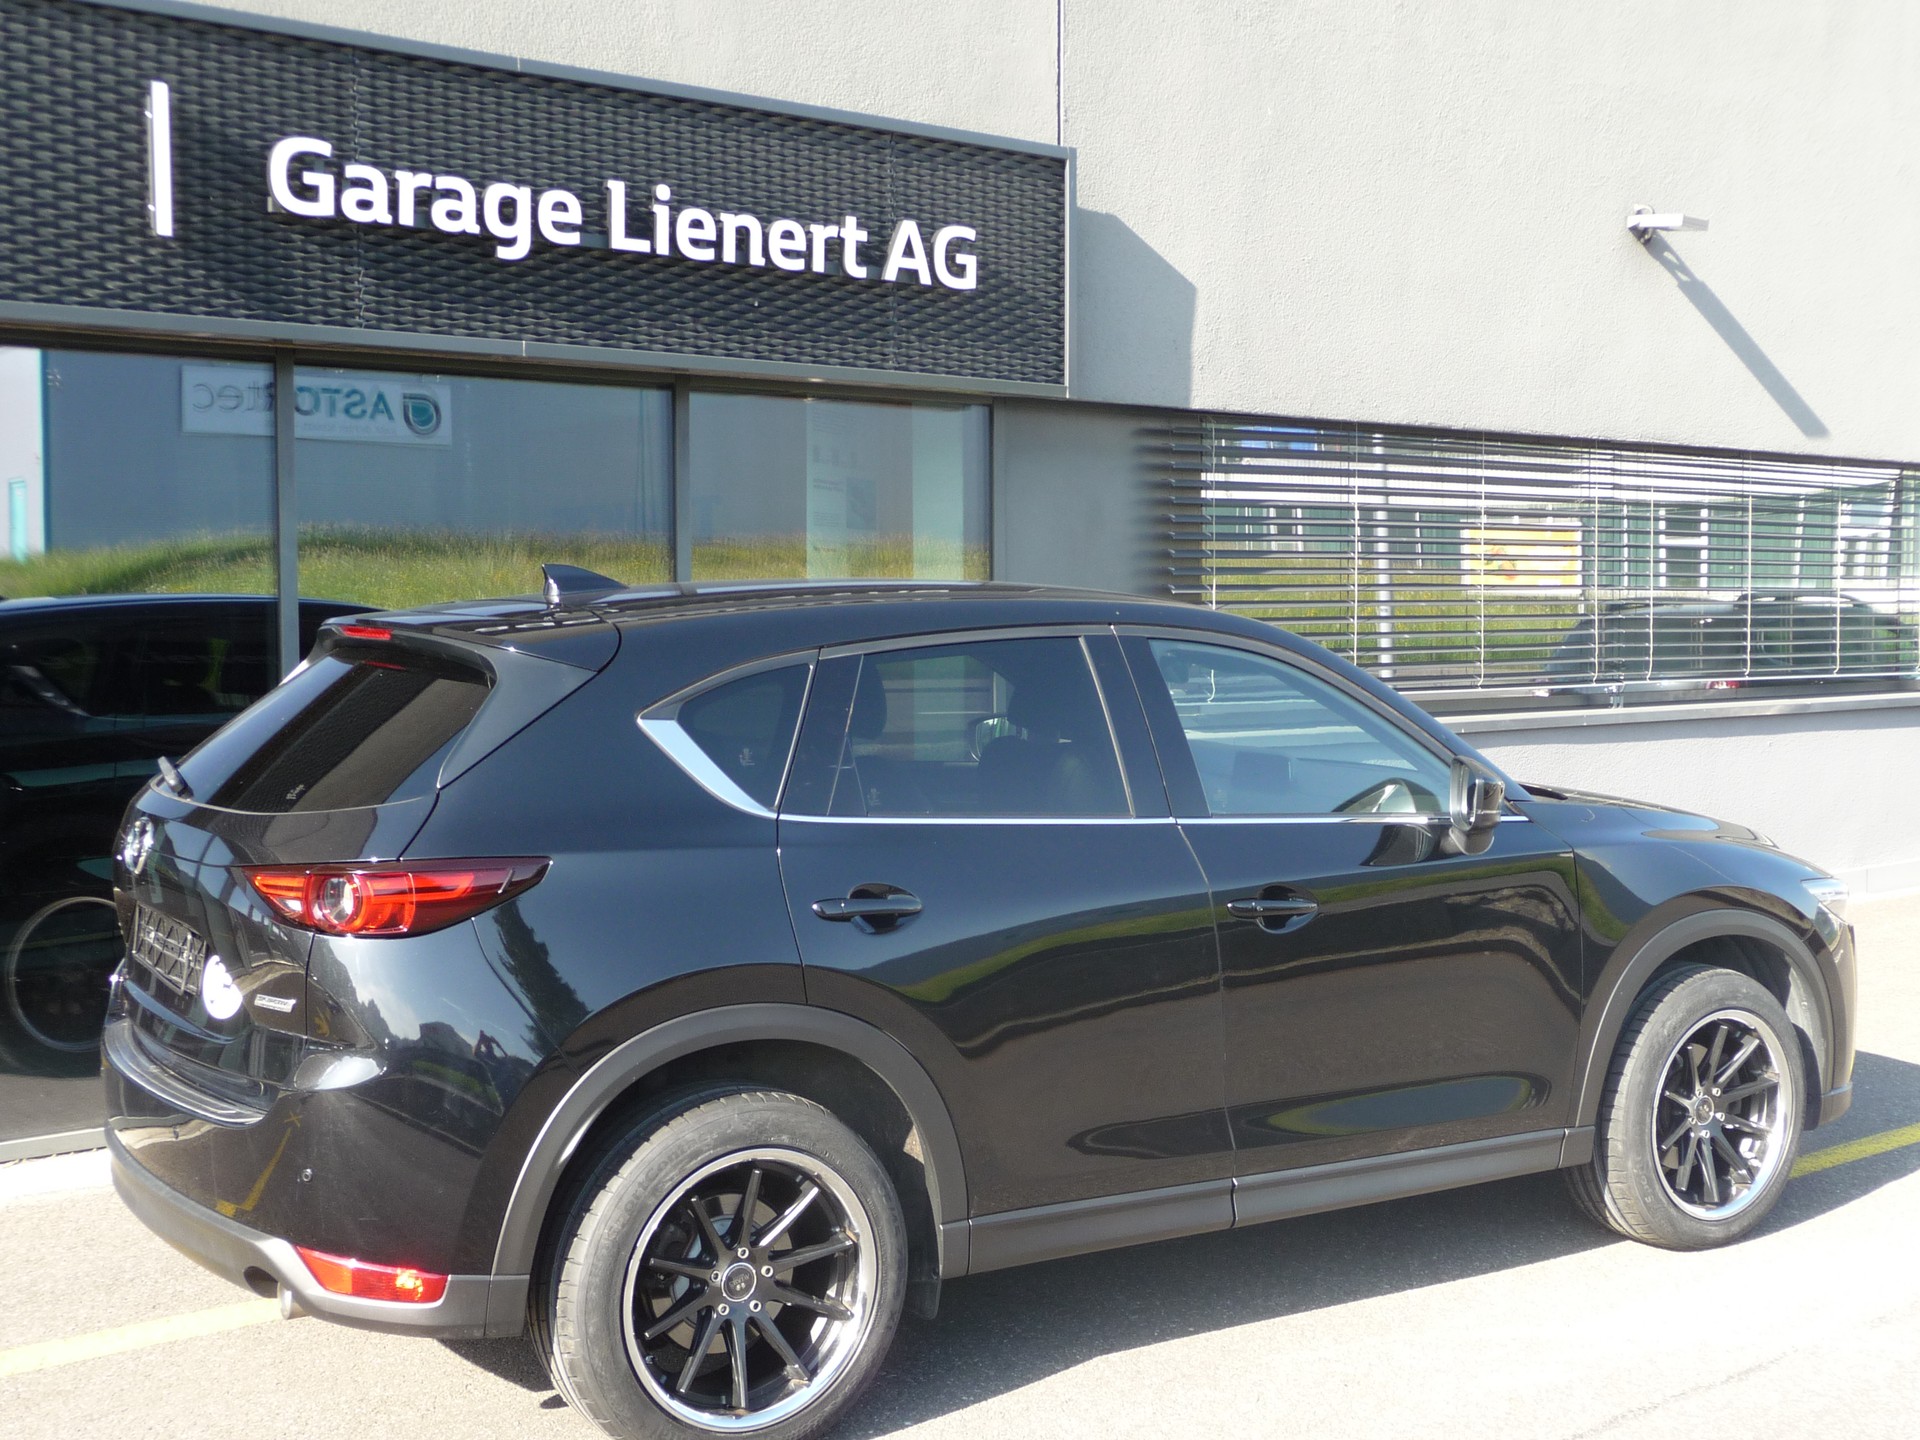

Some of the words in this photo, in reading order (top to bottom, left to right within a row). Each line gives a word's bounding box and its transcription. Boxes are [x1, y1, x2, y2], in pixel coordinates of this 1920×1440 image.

[268, 136, 583, 260] Garage
[605, 178, 869, 279] Lienert
[881, 219, 978, 290] AG
